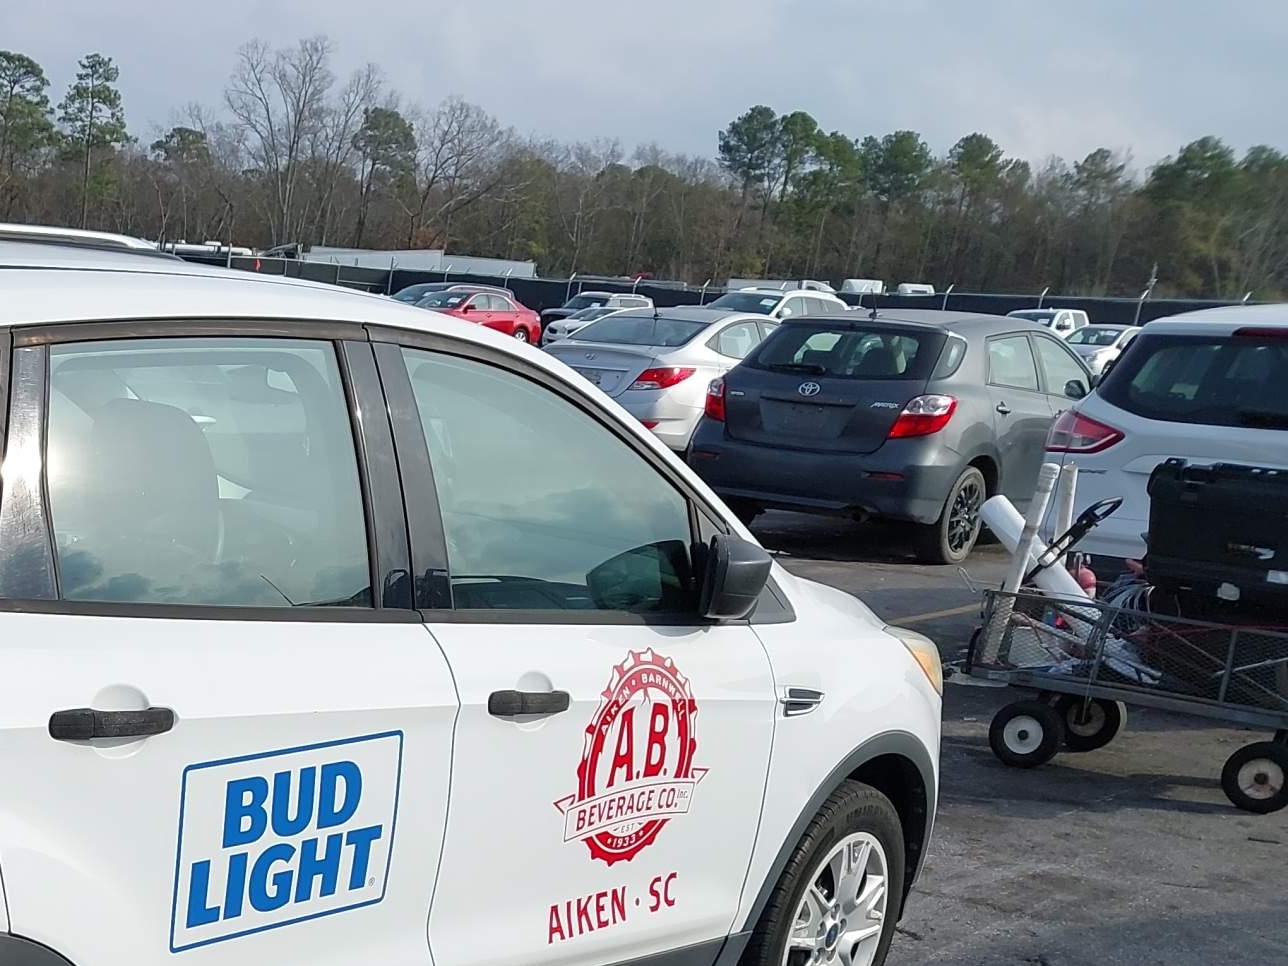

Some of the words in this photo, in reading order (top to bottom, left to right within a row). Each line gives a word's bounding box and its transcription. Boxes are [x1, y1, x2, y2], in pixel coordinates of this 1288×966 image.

[600, 686, 631, 736] AIKEN
[641, 673, 685, 721] BARNWELL
[222, 760, 363, 849] BUD
[575, 789, 655, 832] BEVERAGE
[658, 787, 678, 809] CO.
[620, 823, 636, 834] EST
[612, 835, 637, 848] 1933
[186, 824, 383, 928] LIGHT
[548, 885, 626, 944] AIKEN
[649, 871, 677, 912] SC
